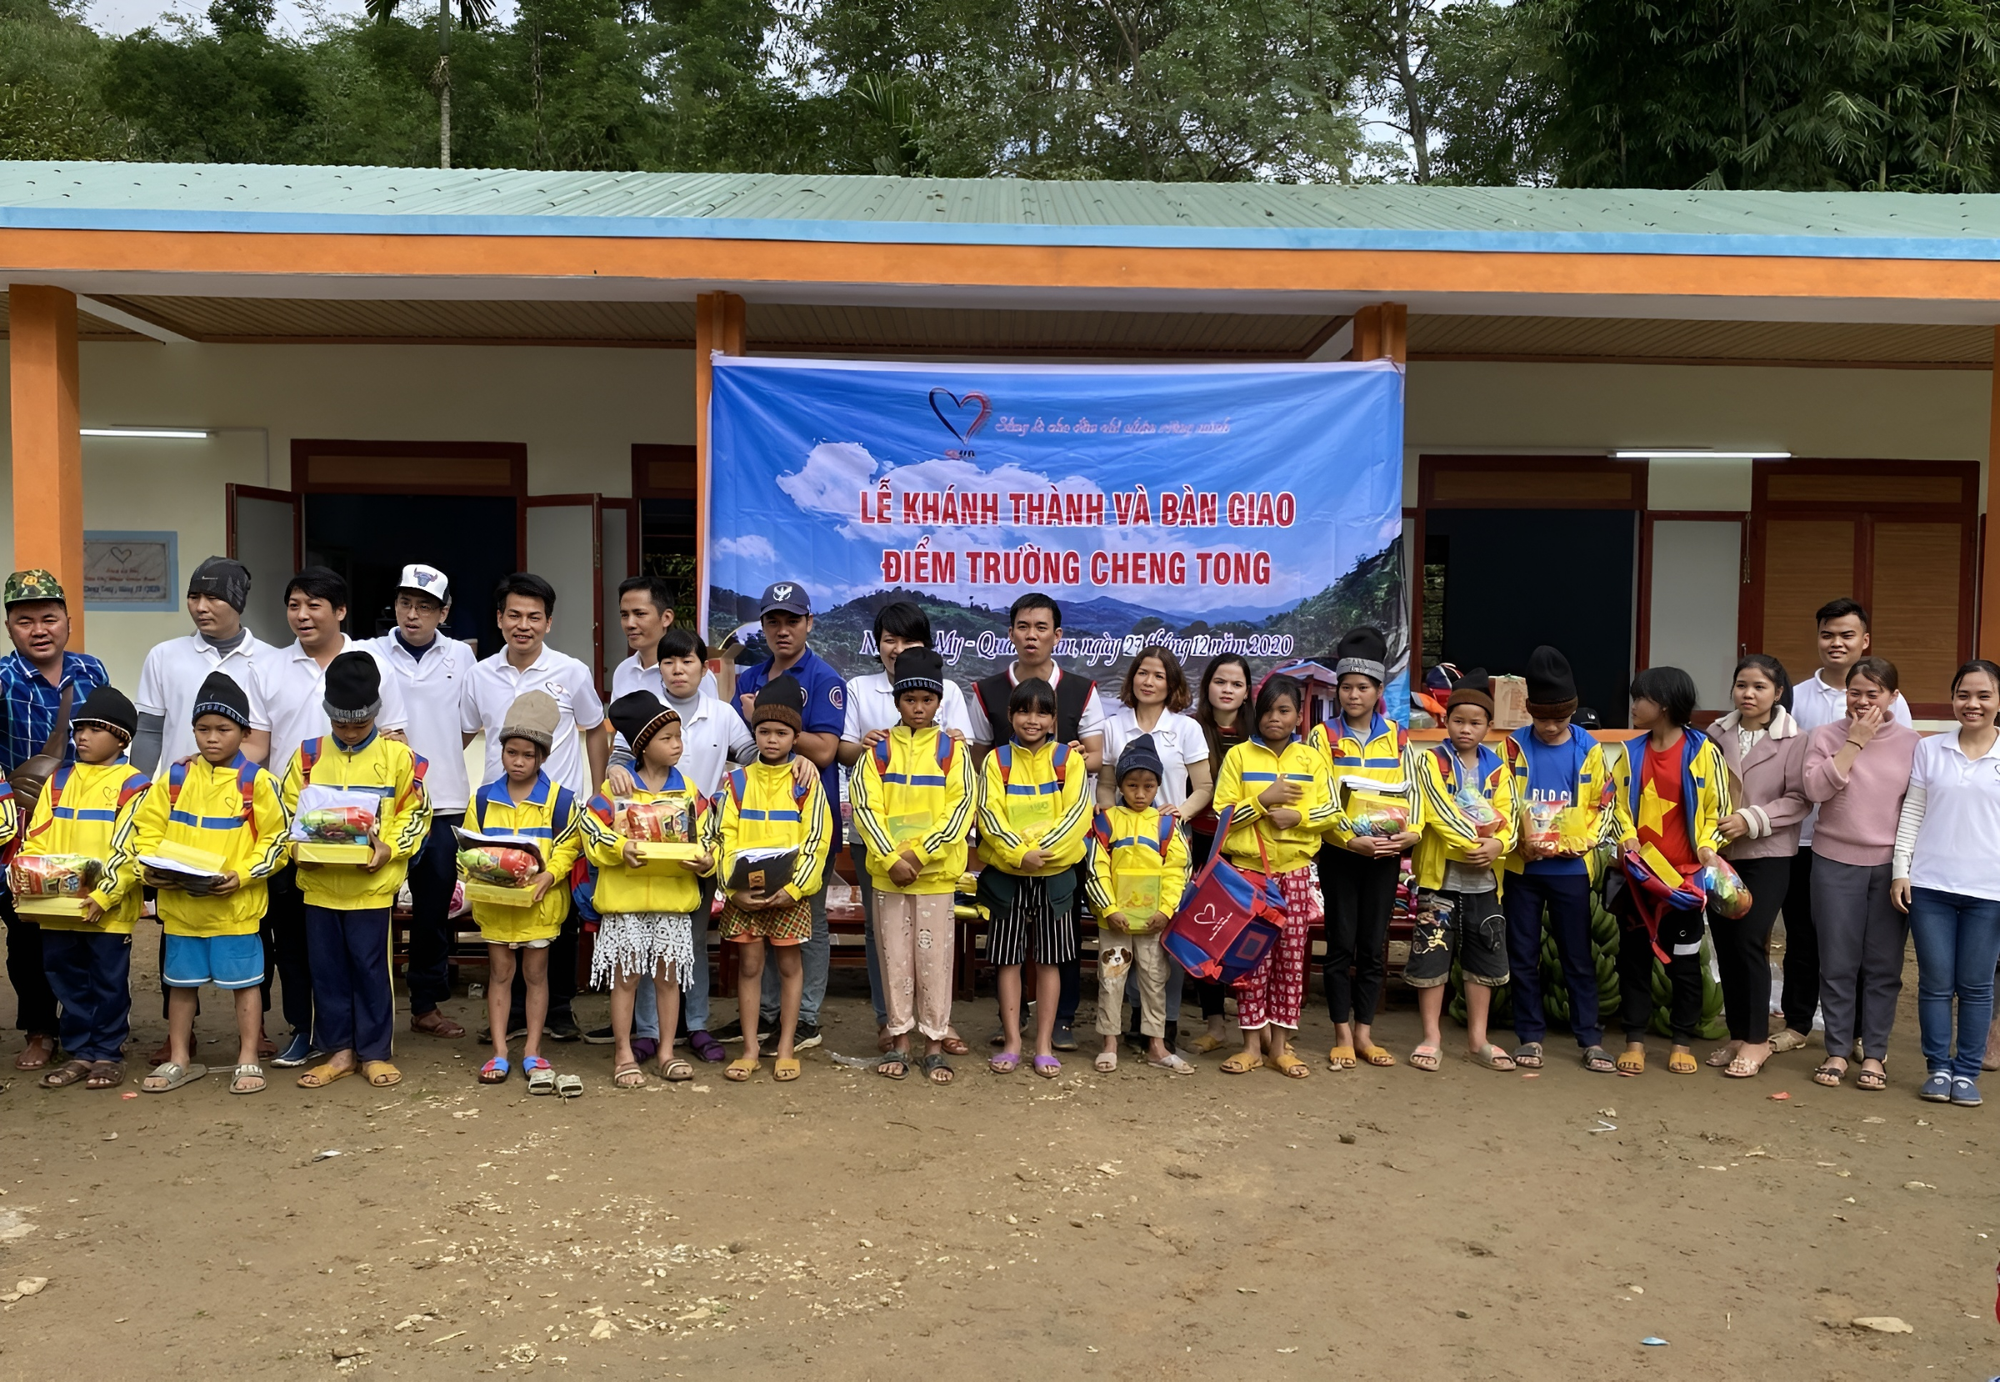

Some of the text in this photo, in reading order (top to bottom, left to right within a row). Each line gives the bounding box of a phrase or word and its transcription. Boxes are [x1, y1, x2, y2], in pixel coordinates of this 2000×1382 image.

[859, 478, 1297, 528] LỄ KHÁNH THÀNH VÀ BÀN GIAO
[881, 535, 1272, 586] ĐIỂM TRƯỜNG CHENG TONG
[1080, 631, 1122, 666] ngày
[1123, 634, 1144, 657] 27
[1190, 634, 1210, 656] 12
[1209, 632, 1247, 656] năm
[1247, 633, 1294, 656] 2020
